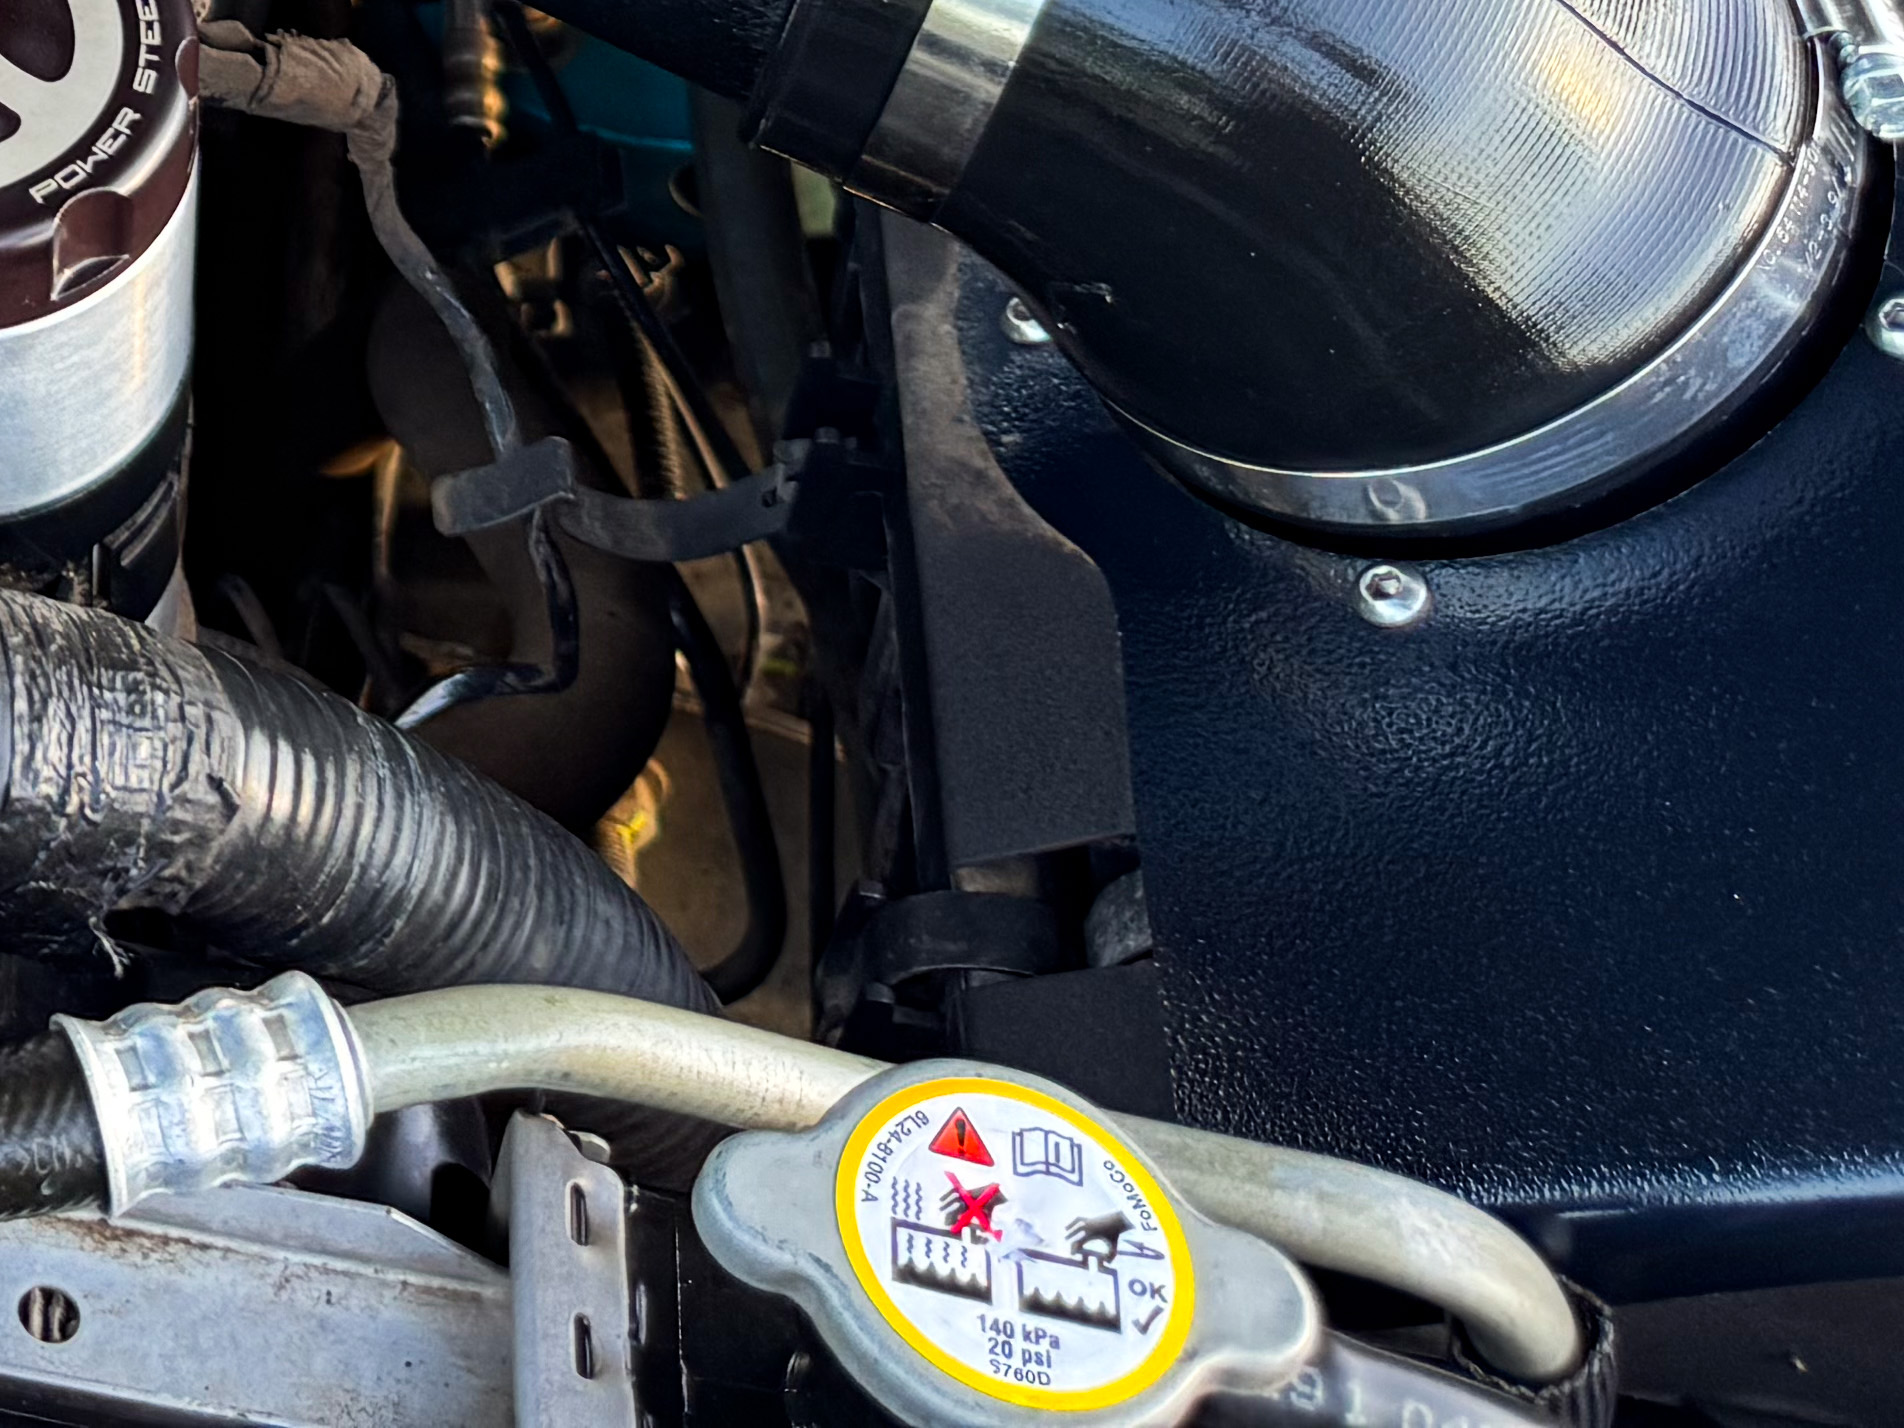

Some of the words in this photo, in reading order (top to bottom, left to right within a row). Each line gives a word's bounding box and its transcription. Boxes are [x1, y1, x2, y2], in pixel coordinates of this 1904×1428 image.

[29, 106, 142, 205] POWER
[861, 1109, 930, 1204] 8L24-8100-A
[1102, 1158, 1159, 1232] FoMoCo
[1127, 1277, 1170, 1304] OK
[976, 1313, 1016, 1339] 140
[1022, 1321, 1061, 1351] kPa
[987, 1336, 1014, 1361] 20
[1021, 1345, 1053, 1370] psi
